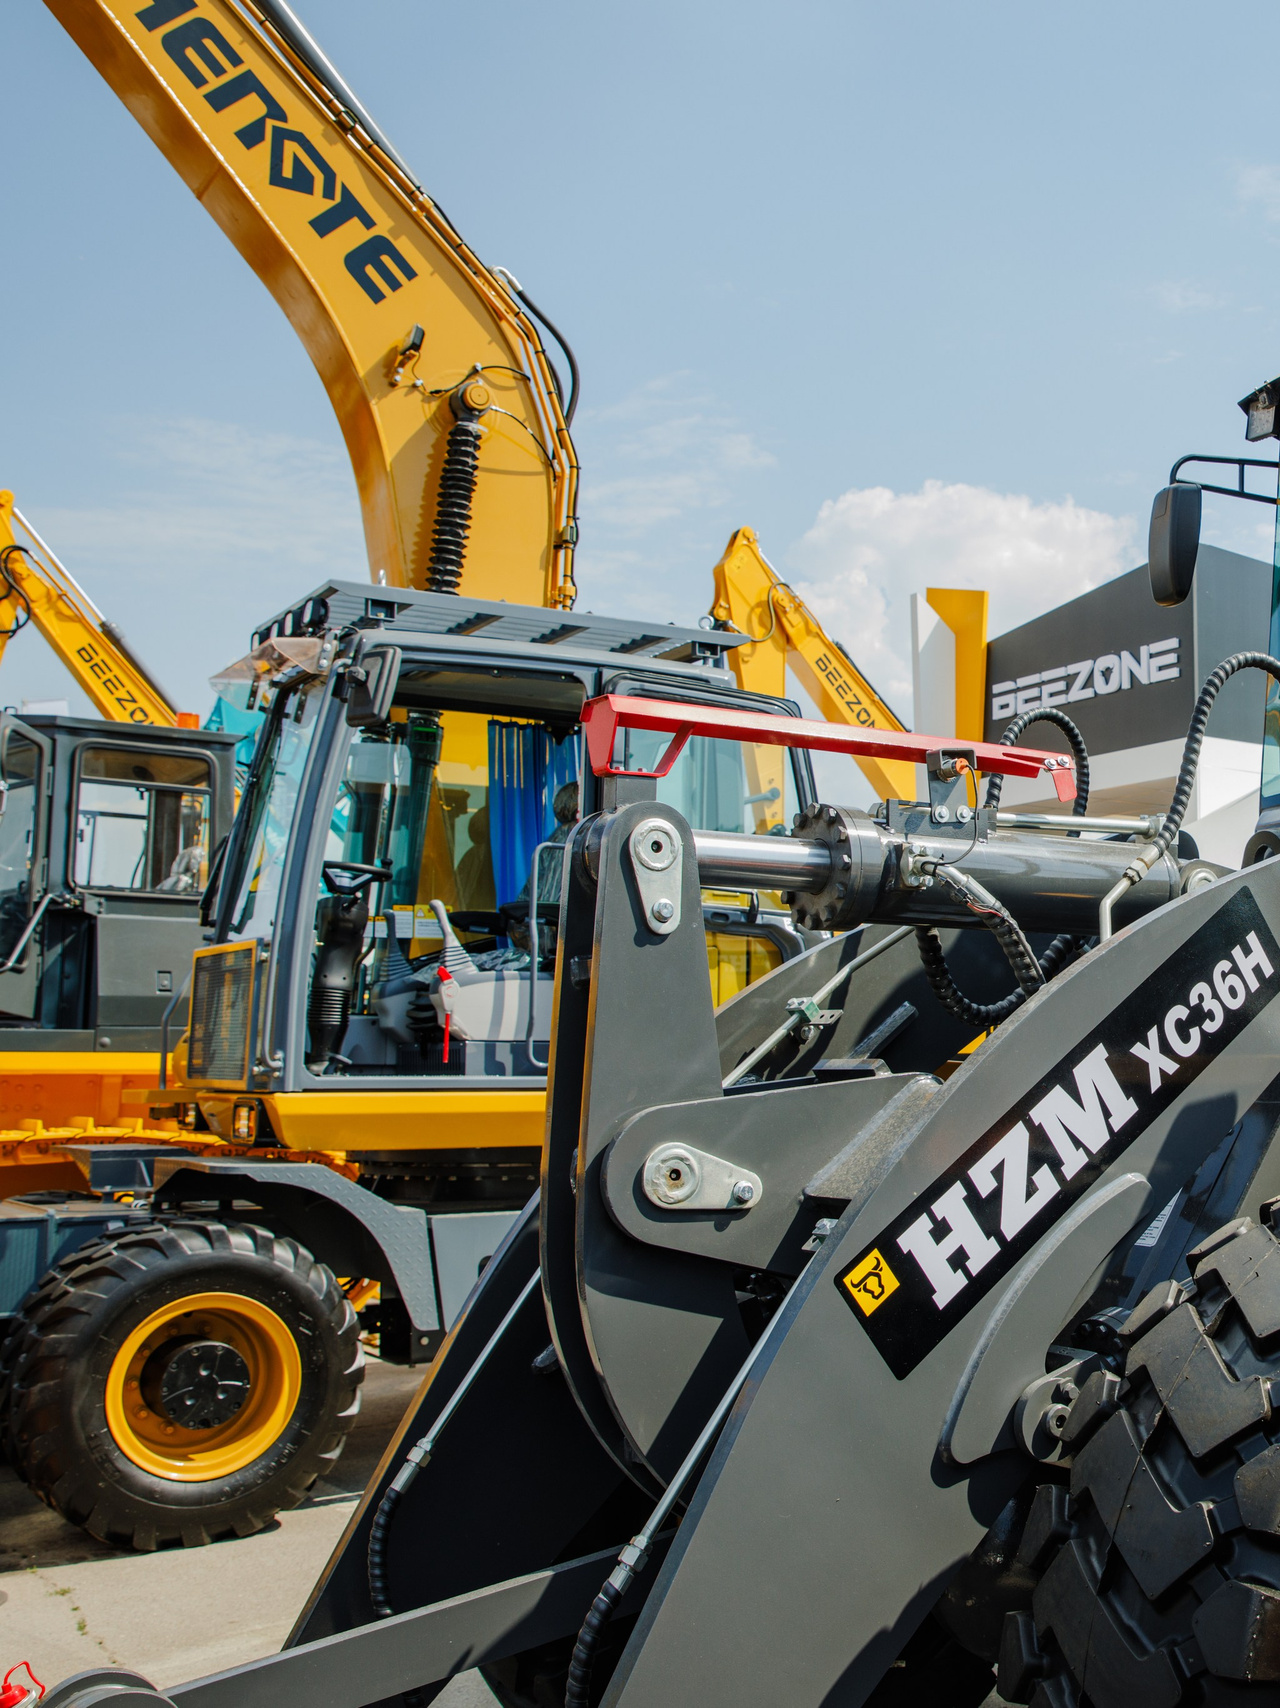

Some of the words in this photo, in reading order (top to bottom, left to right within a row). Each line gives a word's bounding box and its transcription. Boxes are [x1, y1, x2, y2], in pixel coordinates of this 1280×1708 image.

[77, 643, 154, 726] BEEZO
[992, 637, 1180, 721] BEEZONE
[896, 1042, 1139, 1310] HZM
[1130, 930, 1275, 1094] XC36H
